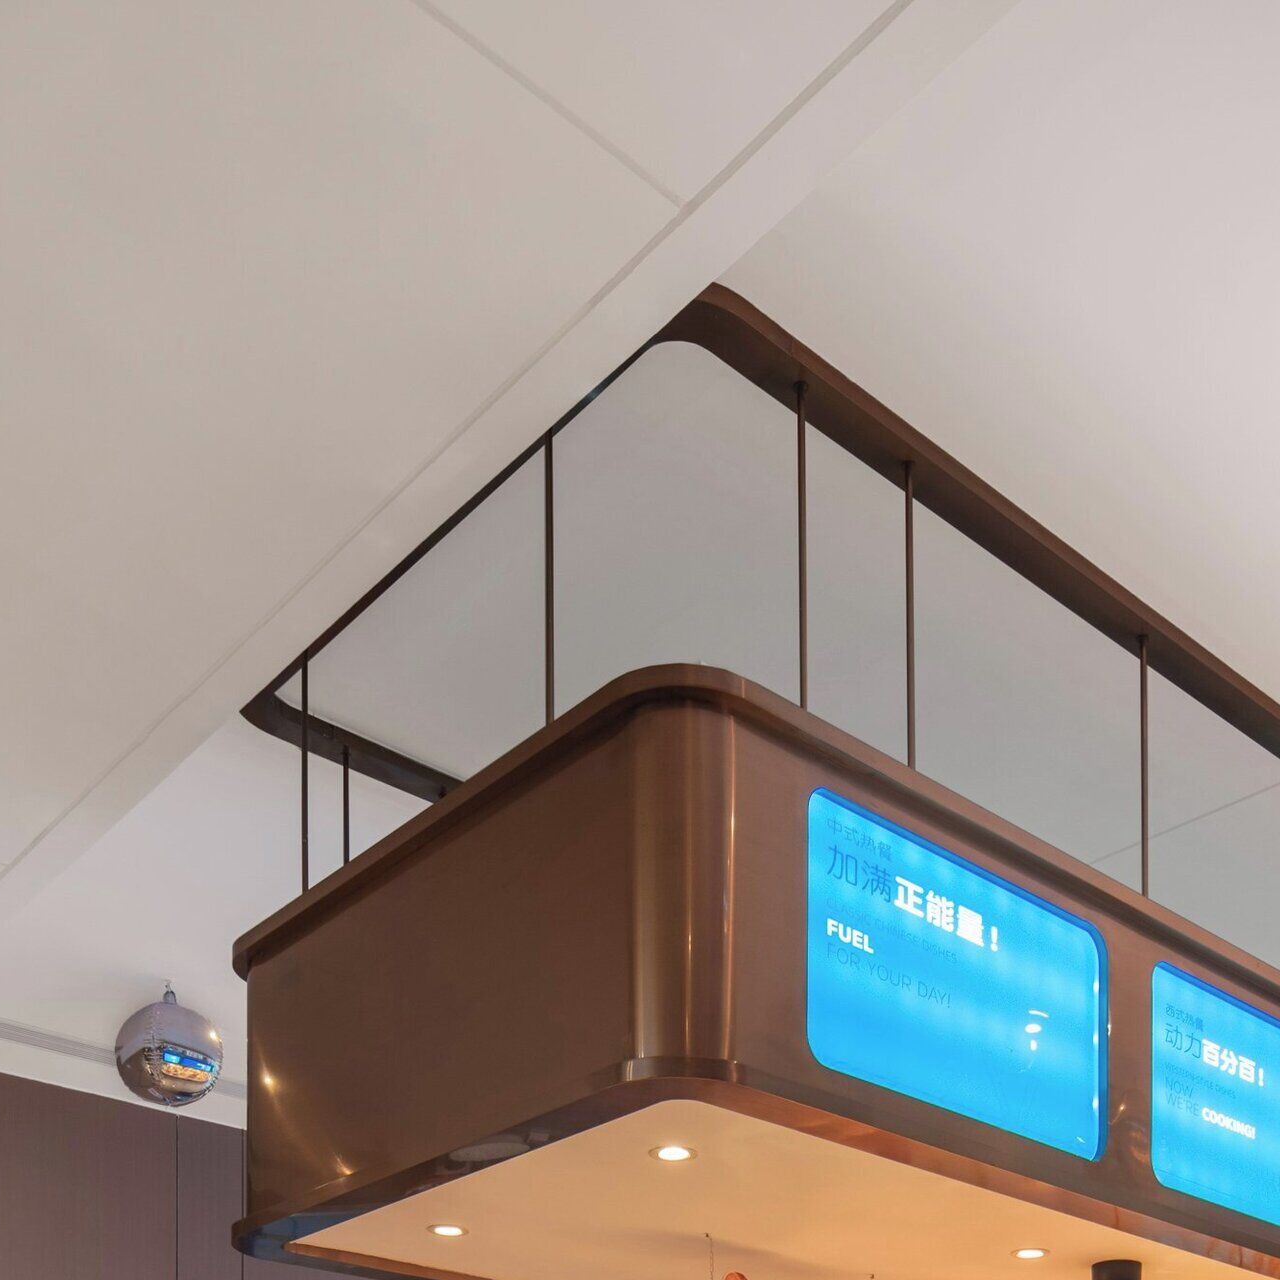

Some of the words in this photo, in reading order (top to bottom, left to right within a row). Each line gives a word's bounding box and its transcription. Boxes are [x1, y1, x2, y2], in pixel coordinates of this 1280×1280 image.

[826, 918, 875, 954] FUEL
[827, 943, 860, 969] FOR
[867, 963, 912, 992] YOUR
[917, 980, 952, 1009] DAY!
[1165, 1023, 1265, 1087] 动力百分百！
[1165, 1077, 1194, 1099] NOW
[1201, 1106, 1257, 1140] COOKING!
